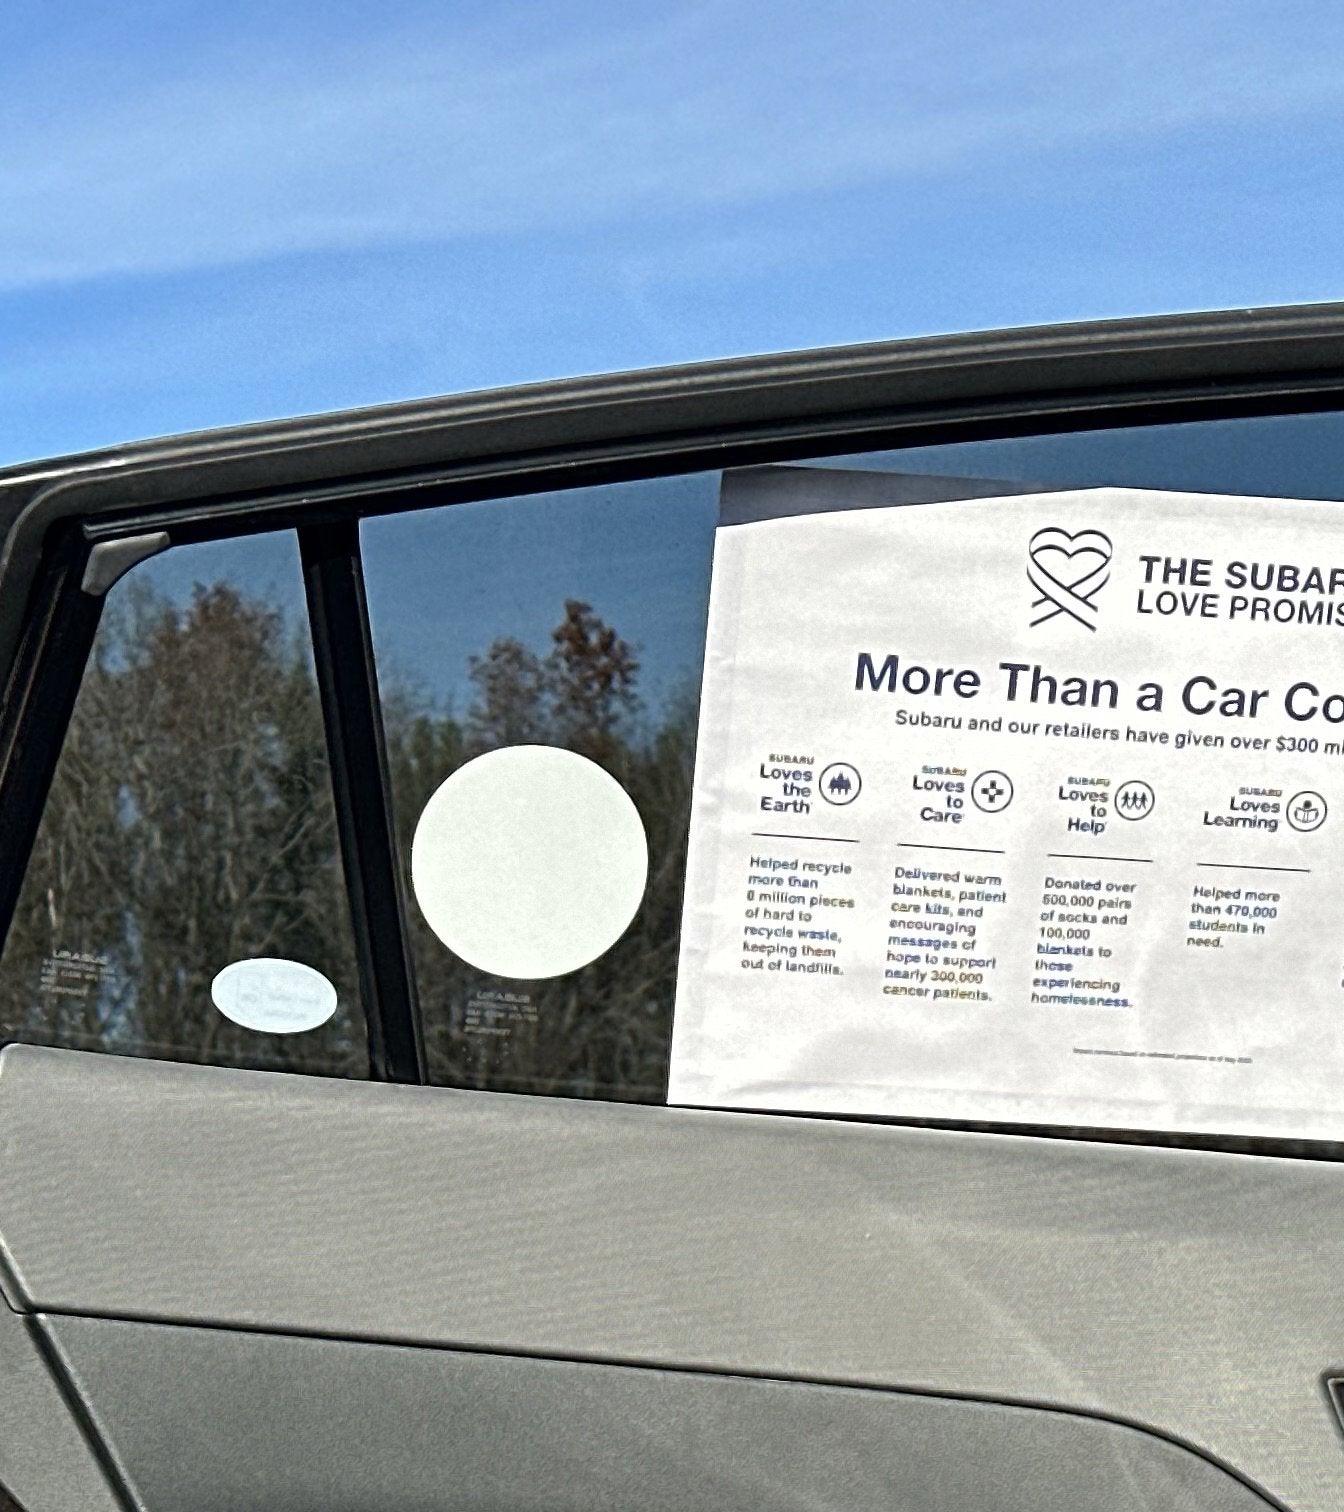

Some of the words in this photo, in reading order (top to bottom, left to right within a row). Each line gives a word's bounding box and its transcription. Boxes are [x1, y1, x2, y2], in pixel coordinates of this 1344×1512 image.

[1139, 555, 1213, 587] THE
[1137, 589, 1219, 618] LOVE
[855, 652, 981, 698] More
[999, 662, 1118, 708] Than
[1136, 683, 1163, 712] a
[1182, 675, 1269, 718] Car
[895, 709, 961, 729] Subaru
[968, 717, 1002, 732] and
[1008, 721, 1040, 736] our
[1045, 723, 1119, 741] retailers
[1126, 726, 1169, 744] have
[1176, 730, 1224, 749] given
[1230, 736, 1271, 751] over
[1276, 736, 1319, 753] $300
[769, 754, 815, 765] SUBARU
[760, 763, 813, 782] Loves
[783, 782, 811, 798] the
[913, 775, 965, 793] Loves
[947, 794, 964, 809] to
[1058, 786, 1109, 803] Loves
[760, 796, 810, 815] Earth
[1091, 805, 1107, 817] to
[1230, 796, 1280, 813] Loves
[920, 807, 962, 824] Care
[1204, 811, 1279, 832] Learning
[1068, 817, 1105, 835] Help
[750, 856, 798, 872] Helped
[803, 862, 852, 876] recycle
[748, 875, 784, 887] more
[788, 876, 818, 889] than
[895, 867, 960, 883] Delivered
[964, 873, 1002, 885] warm
[1044, 877, 1101, 891] Donated
[1106, 882, 1137, 893] over
[759, 891, 805, 905] million
[810, 895, 855, 909] pieces
[893, 883, 954, 901] blankets,
[959, 889, 1007, 904] patient
[1193, 886, 1241, 901] Helped
[1245, 890, 1280, 902] more
[891, 903, 921, 914] care
[925, 902, 953, 917] kits,
[957, 906, 983, 918] and
[1098, 896, 1132, 910] pairs
[1191, 903, 1221, 915] than
[745, 908, 760, 919] of
[763, 909, 794, 921] hard
[799, 911, 812, 923] to
[1040, 910, 1055, 921] of
[1058, 912, 1097, 924] socks
[1102, 914, 1127, 925] and
[744, 925, 793, 939] recycle
[798, 930, 842, 943] waste,
[889, 920, 976, 937] encouraging
[1040, 927, 1090, 940] 100,000
[1189, 919, 1248, 934] students
[1253, 922, 1265, 935] in
[743, 941, 797, 957] keeping
[802, 944, 836, 958] them
[888, 936, 958, 950] messages
[962, 939, 977, 950] of
[1186, 935, 1223, 948] need.
[1037, 943, 1093, 957] blankets
[1099, 946, 1112, 958] to
[741, 958, 763, 970] out
[768, 960, 782, 972] of
[786, 961, 844, 976] landfills.
[887, 950, 921, 965] hope
[925, 954, 939, 965] to
[943, 955, 997, 969] support
[1035, 959, 1073, 972] those
[885, 968, 927, 983] nearly
[931, 970, 983, 984] 300,000
[1033, 977, 1120, 992] experiencing
[883, 985, 930, 997] cancer
[933, 987, 992, 1001] patients.
[1031, 992, 1133, 1008] homelessness.
